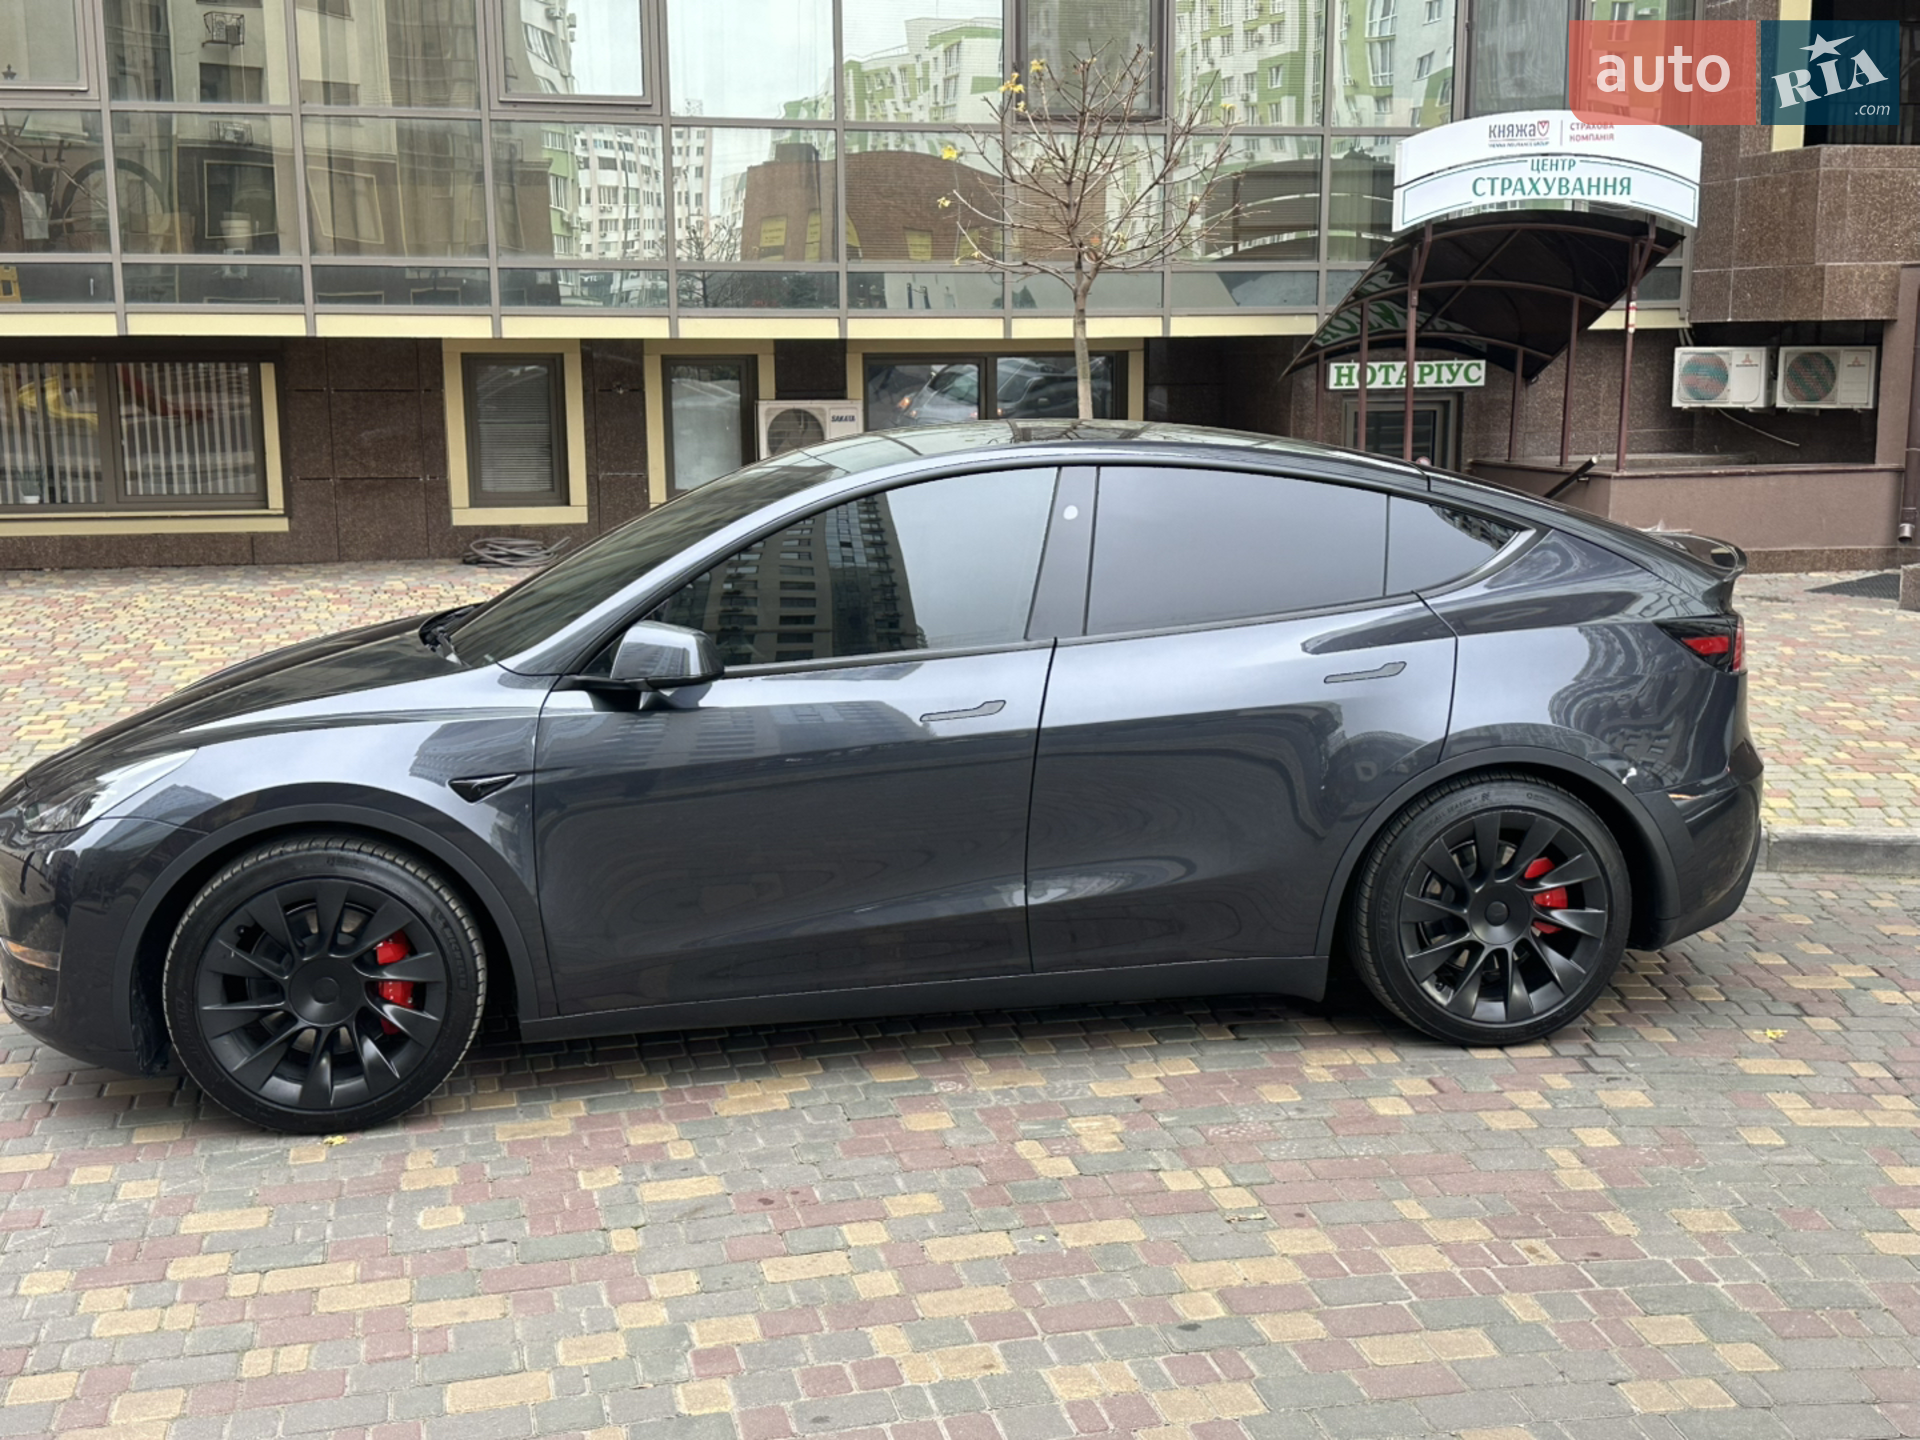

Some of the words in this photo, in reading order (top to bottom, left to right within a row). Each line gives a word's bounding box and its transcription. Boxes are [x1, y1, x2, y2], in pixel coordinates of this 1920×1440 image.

[1569, 133, 1615, 143] КОМПАНІЯ
[1530, 158, 1577, 173] ЦЕНТР
[1472, 176, 1632, 198] СТРАХУВАННЯ
